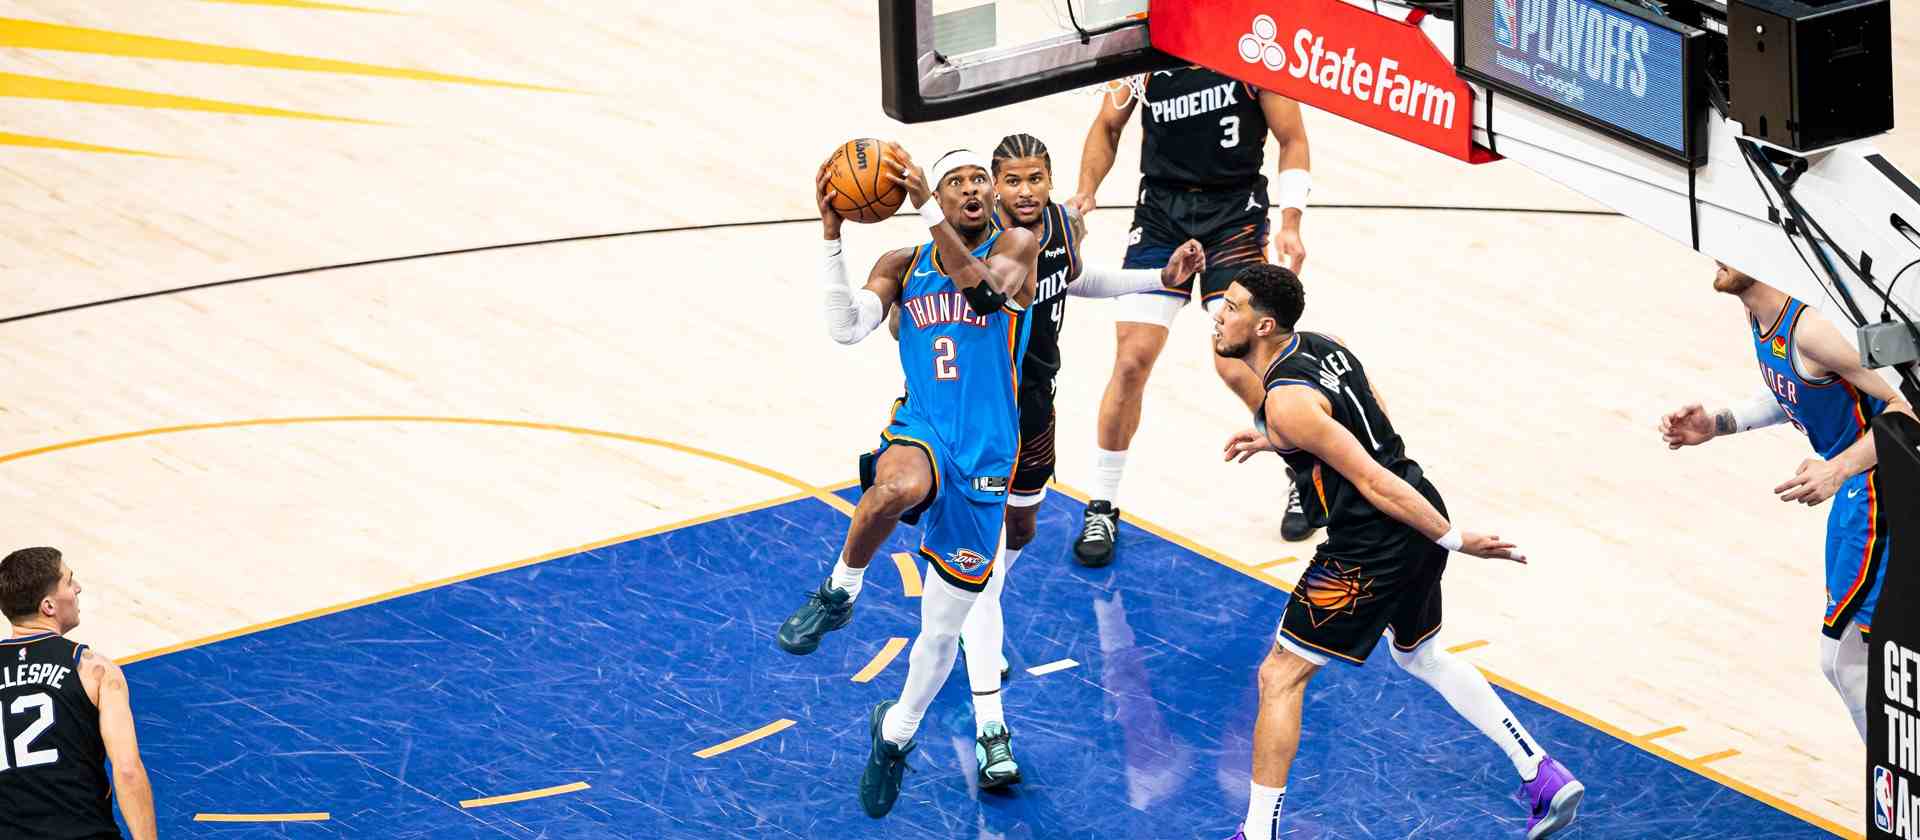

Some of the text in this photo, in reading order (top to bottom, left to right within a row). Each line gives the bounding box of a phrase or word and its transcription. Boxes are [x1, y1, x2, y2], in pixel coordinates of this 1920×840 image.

[1520, 0, 1649, 98] PLAYOFFS
[1151, 81, 1238, 123] PHOENIX
[1219, 116, 1240, 148] 3
[1050, 299, 1063, 332] 4
[933, 336, 959, 380] 2
[1344, 386, 1382, 450] 1
[0, 663, 71, 690] LESPIE
